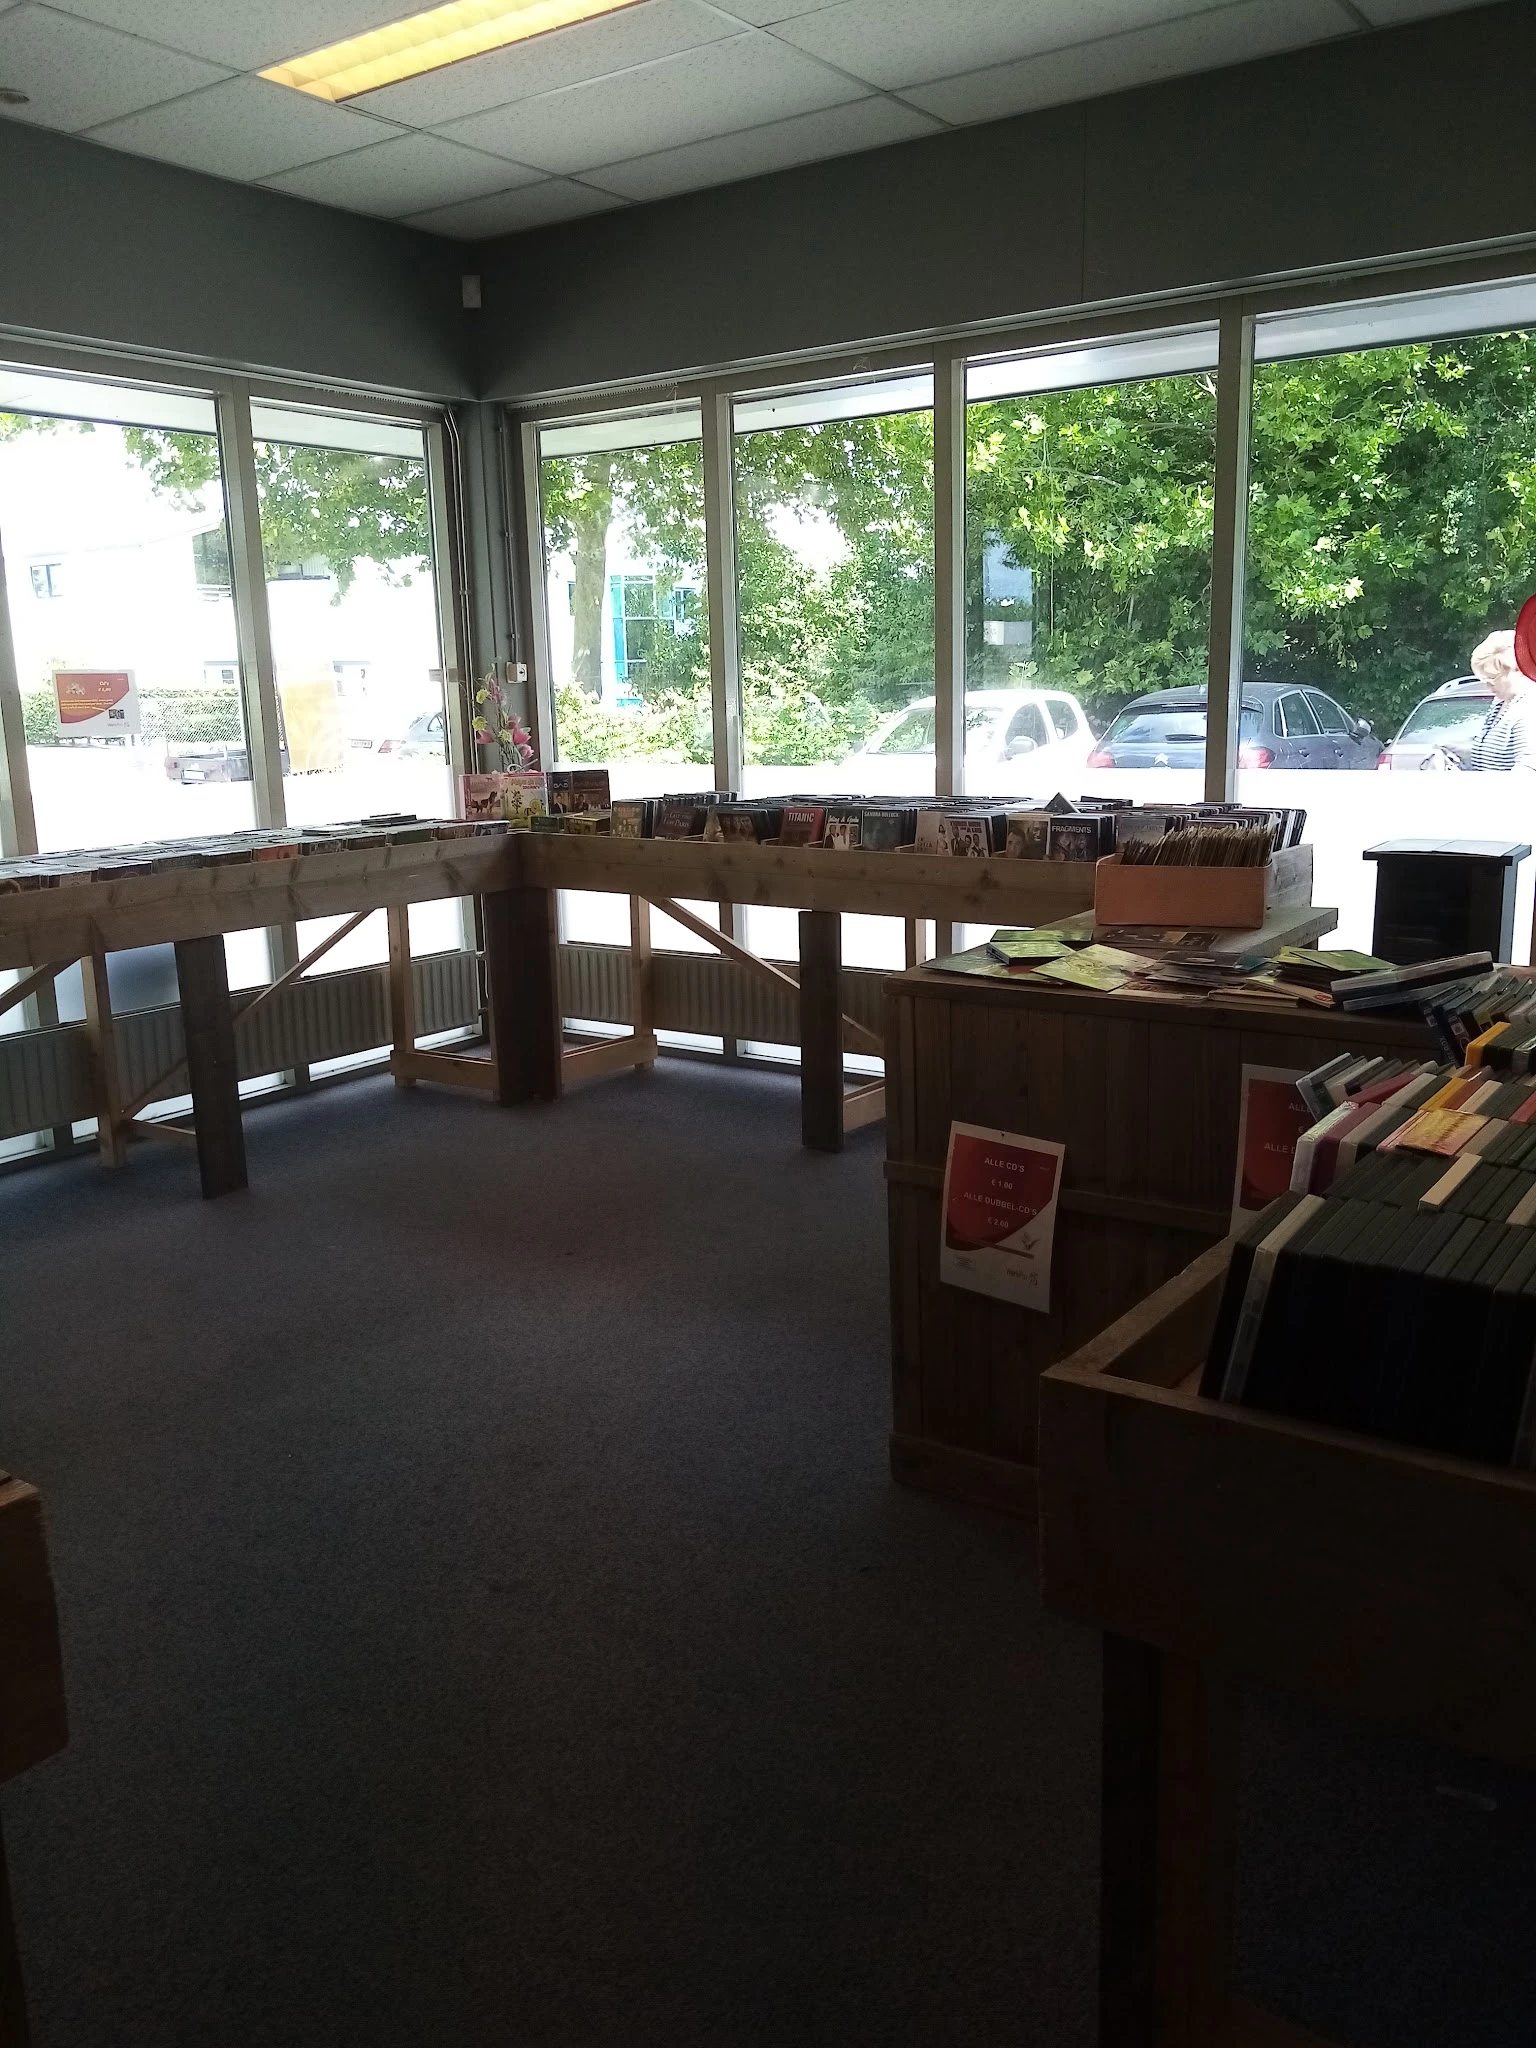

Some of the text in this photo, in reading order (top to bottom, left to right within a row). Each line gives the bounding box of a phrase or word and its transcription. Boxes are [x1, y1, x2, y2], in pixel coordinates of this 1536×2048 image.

[788, 812, 815, 823] TITANIC
[1051, 825, 1092, 834] FRAGMENTS
[1263, 1142, 1289, 1154] ALLE
[984, 1157, 1025, 1173] ALLE CD'S
[991, 1178, 997, 1186] €
[963, 1191, 984, 1202] ALLE
[987, 1216, 992, 1225] €
